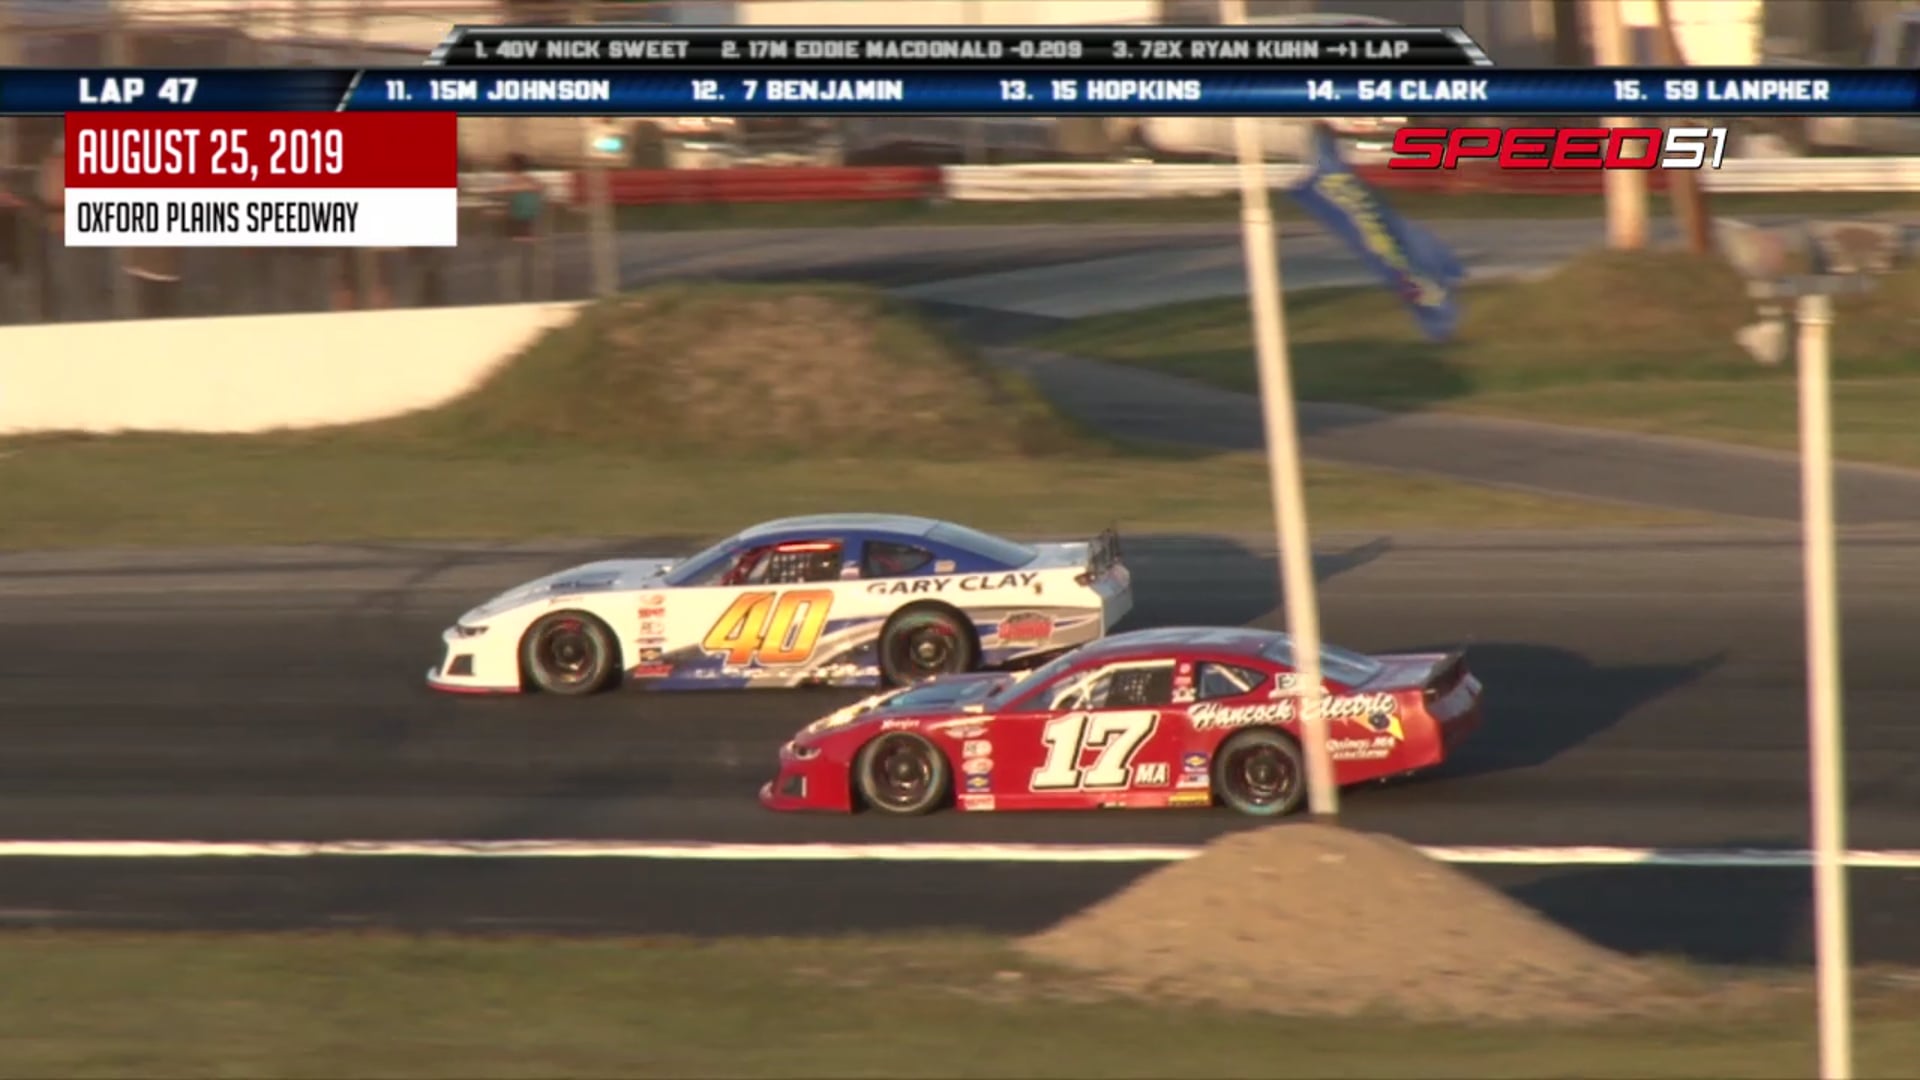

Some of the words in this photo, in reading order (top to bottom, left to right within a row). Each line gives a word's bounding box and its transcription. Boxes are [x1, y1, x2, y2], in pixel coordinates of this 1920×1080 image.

[866, 578, 951, 594] GARY
[701, 588, 835, 667] 40
[1188, 700, 1294, 729] Hancock
[1300, 692, 1398, 720] Electric
[1029, 711, 1162, 792] 17
[1133, 762, 1169, 786] MA
